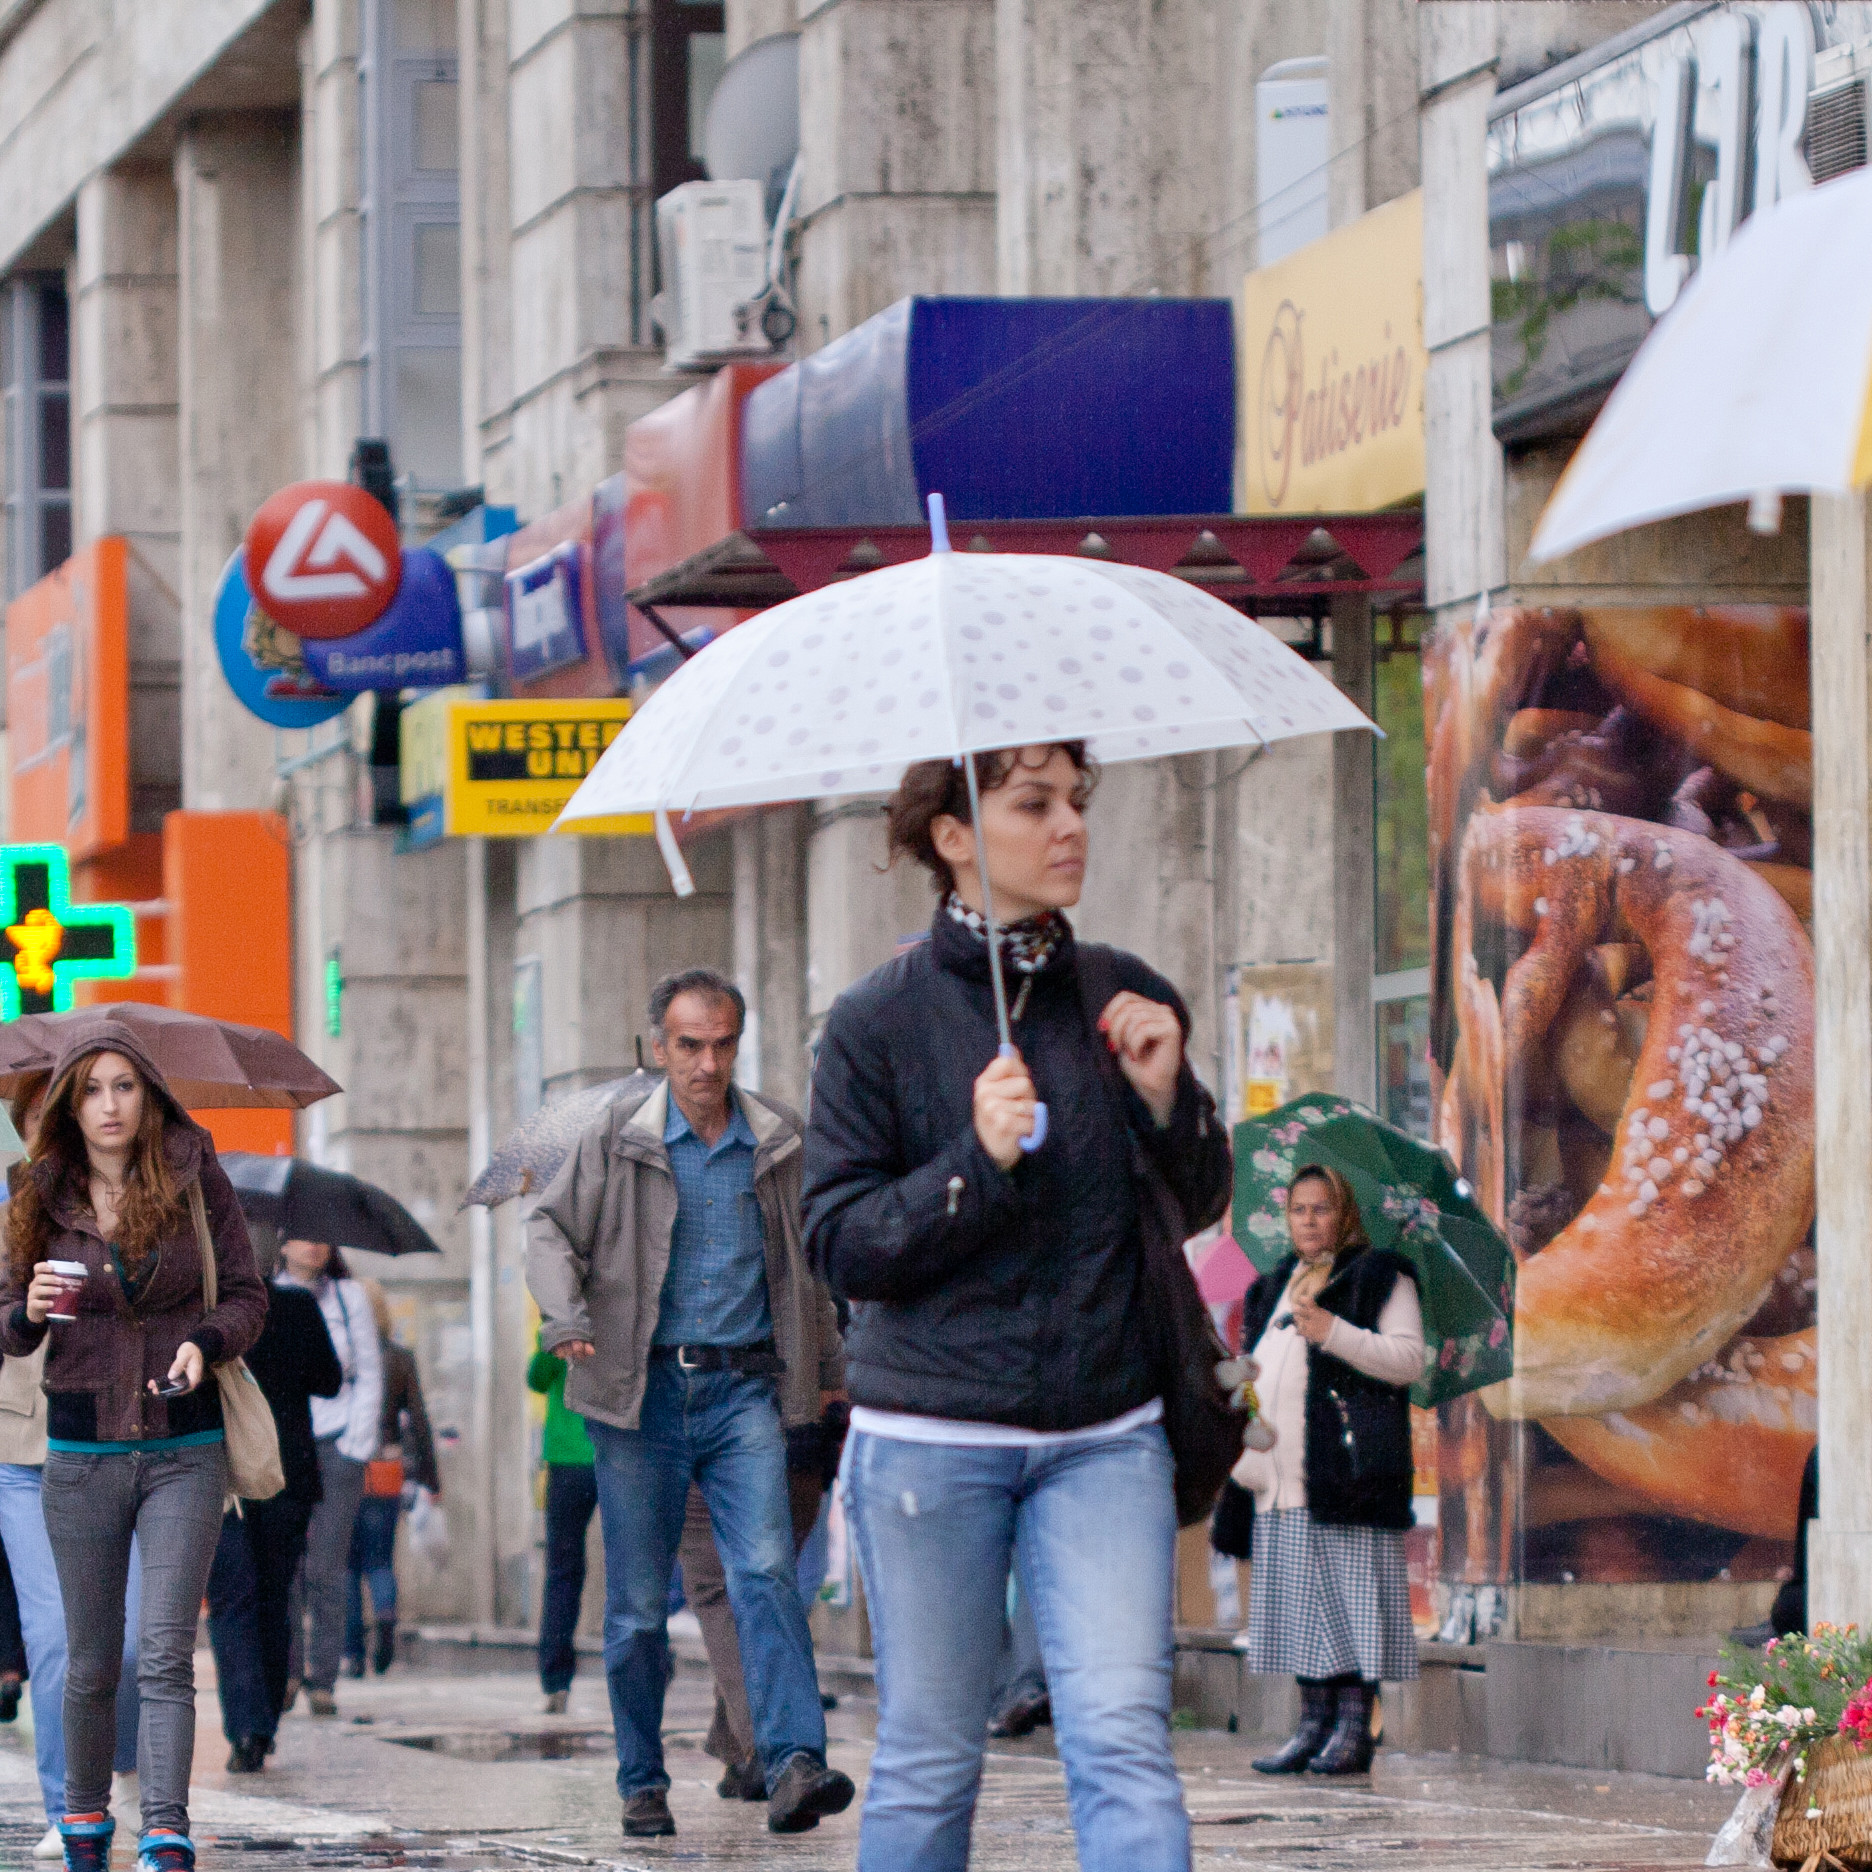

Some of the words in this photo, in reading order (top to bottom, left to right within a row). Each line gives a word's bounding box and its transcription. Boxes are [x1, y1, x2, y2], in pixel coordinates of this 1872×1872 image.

[1260, 299, 1411, 507] Patiserie
[328, 648, 453, 676] Bancpost
[527, 750, 599, 777] UNI
[488, 799, 569, 816] TRANSF
